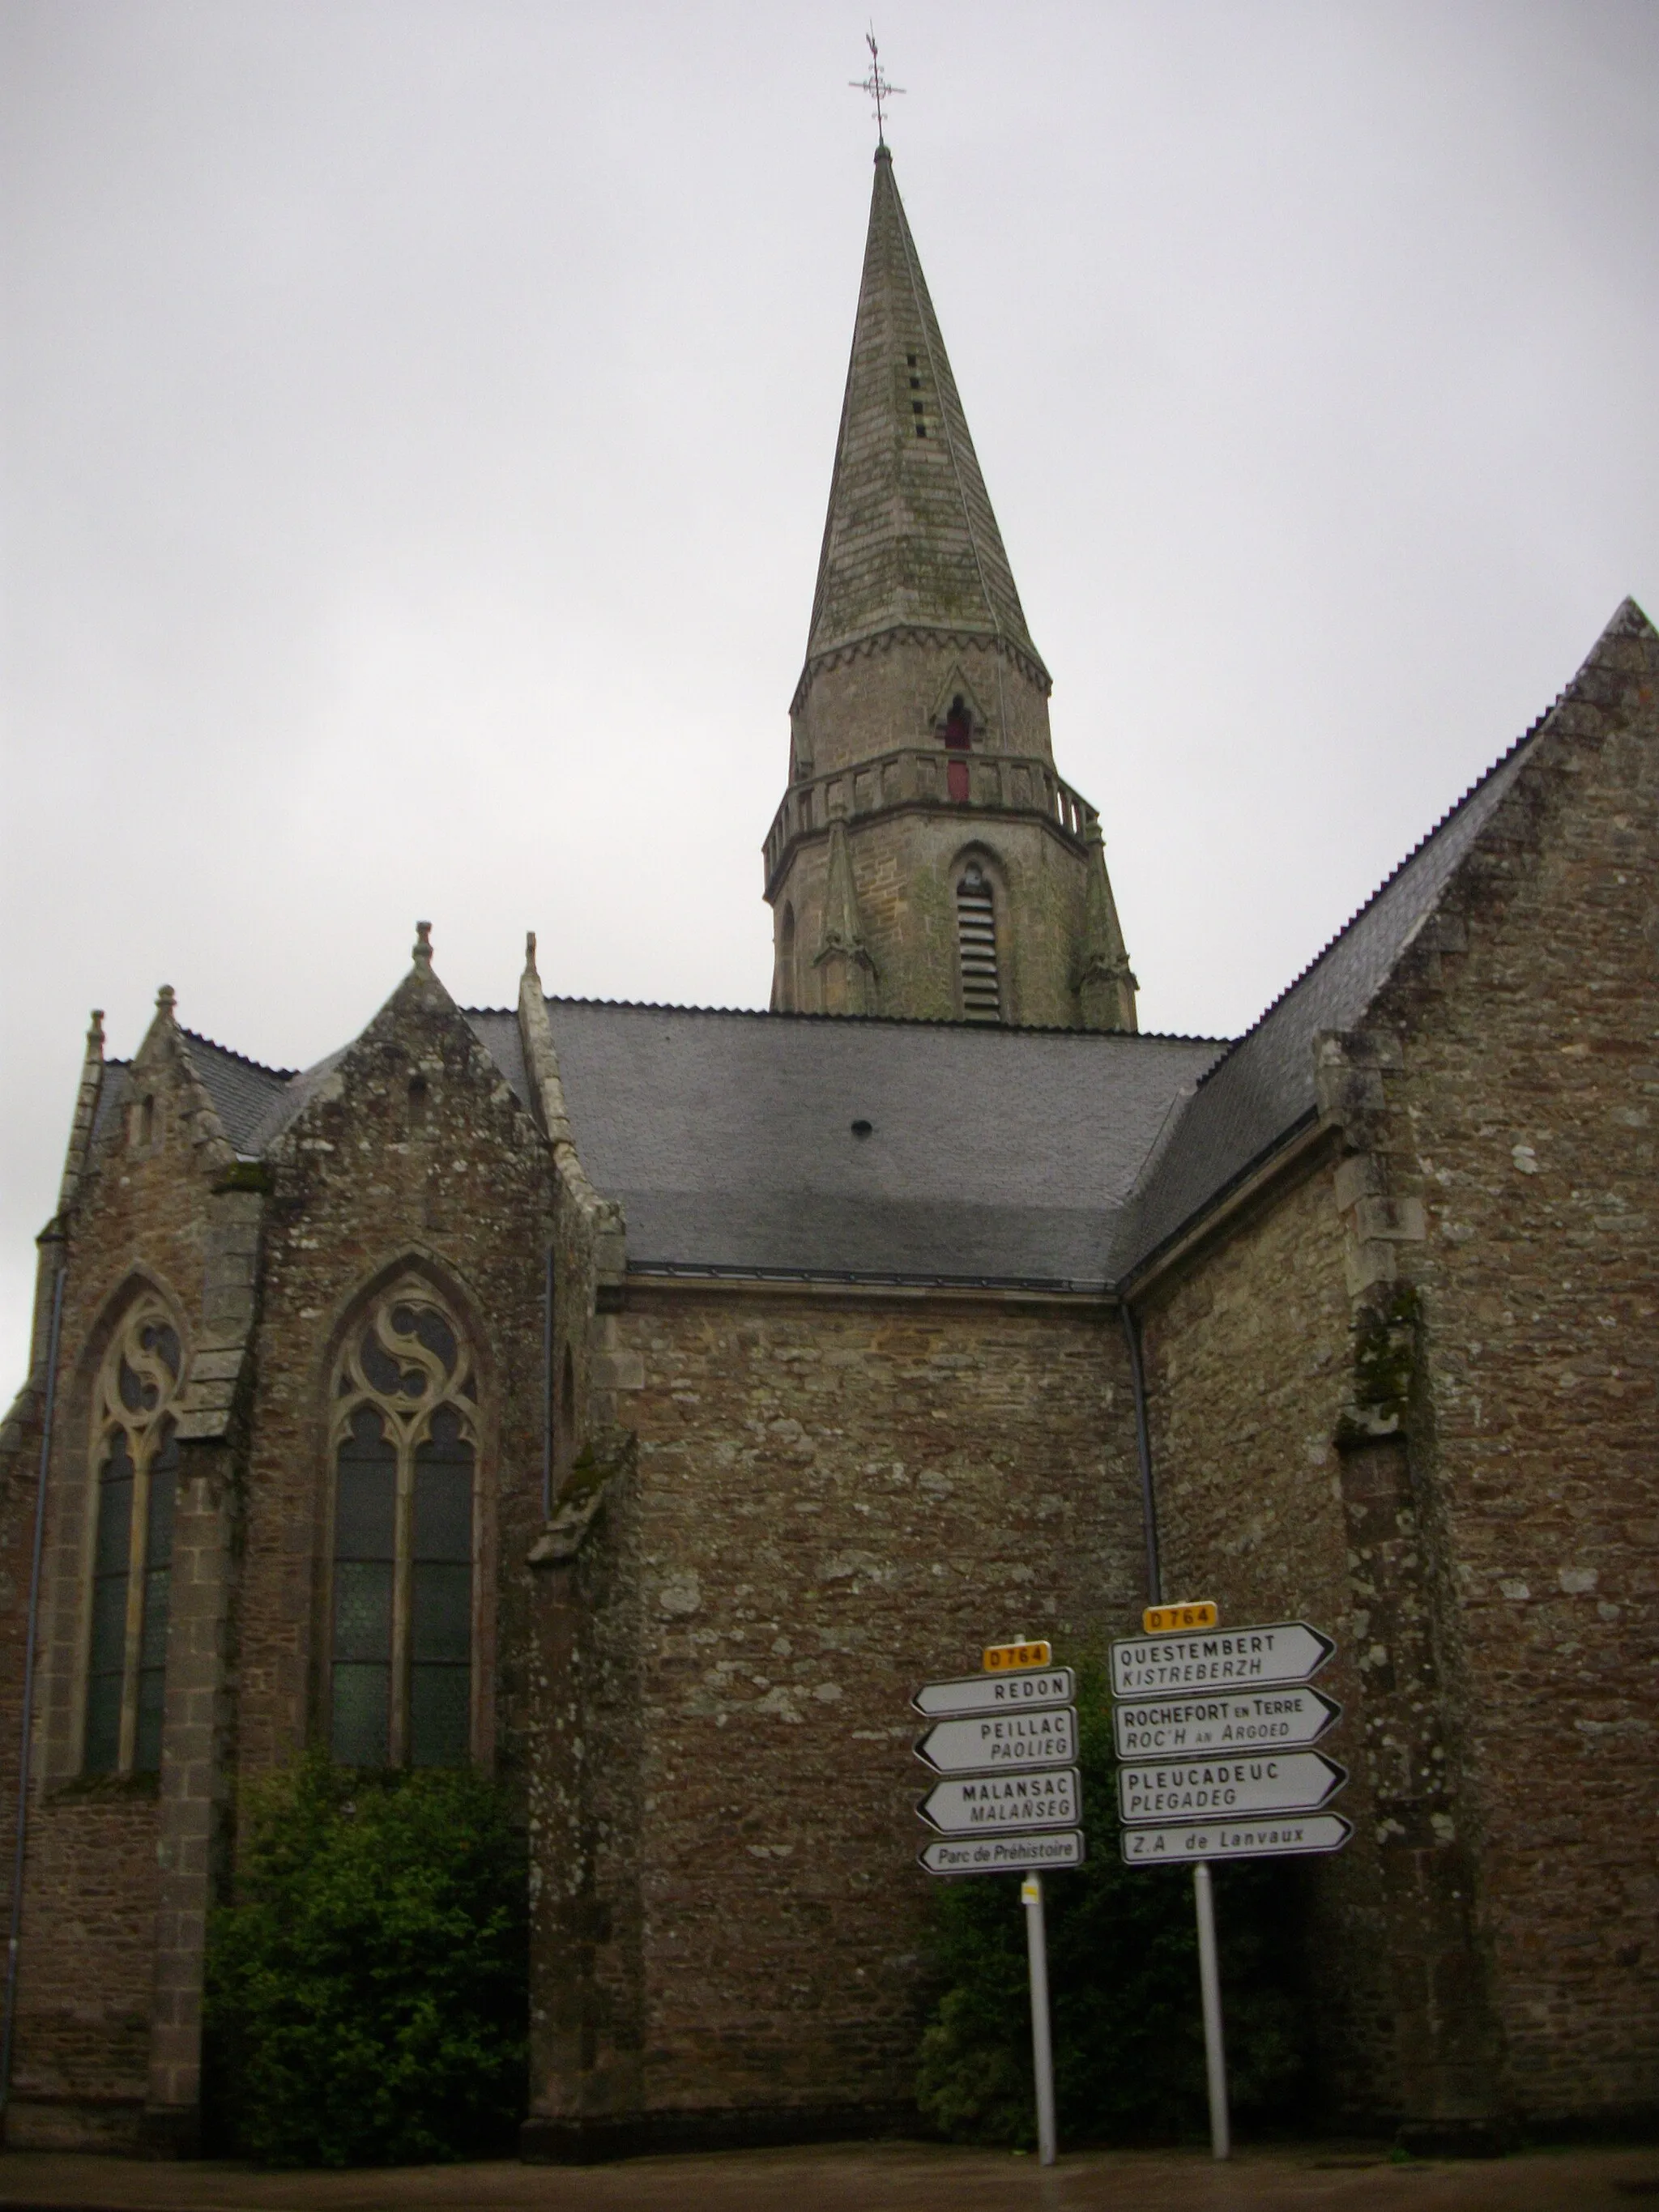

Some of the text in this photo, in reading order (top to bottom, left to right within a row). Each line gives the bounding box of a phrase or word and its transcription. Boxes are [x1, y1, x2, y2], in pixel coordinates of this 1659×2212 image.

[1150, 1608, 1209, 1628] D 764
[990, 1646, 1043, 1668] D 764
[1120, 1634, 1275, 1667] QUESTEMBERT
[1123, 1658, 1262, 1686] KISTREBERZH
[995, 1677, 1064, 1699] REDON
[1124, 1698, 1304, 1728] ROCHEFORT EN TERRE
[980, 1716, 1065, 1740] PEILLAC
[1221, 1722, 1290, 1741] ARGOED
[991, 1738, 1067, 1760] PAOLIEG
[1128, 1762, 1278, 1790] PLEUCADEUC
[962, 1778, 1068, 1801] MALANSAC
[1131, 1788, 1237, 1812] PLEGADEG
[1185, 1833, 1209, 1850] de
[1221, 1828, 1304, 1848] Lanvaux
[938, 1839, 1073, 1865] Parc de Préhistoire
